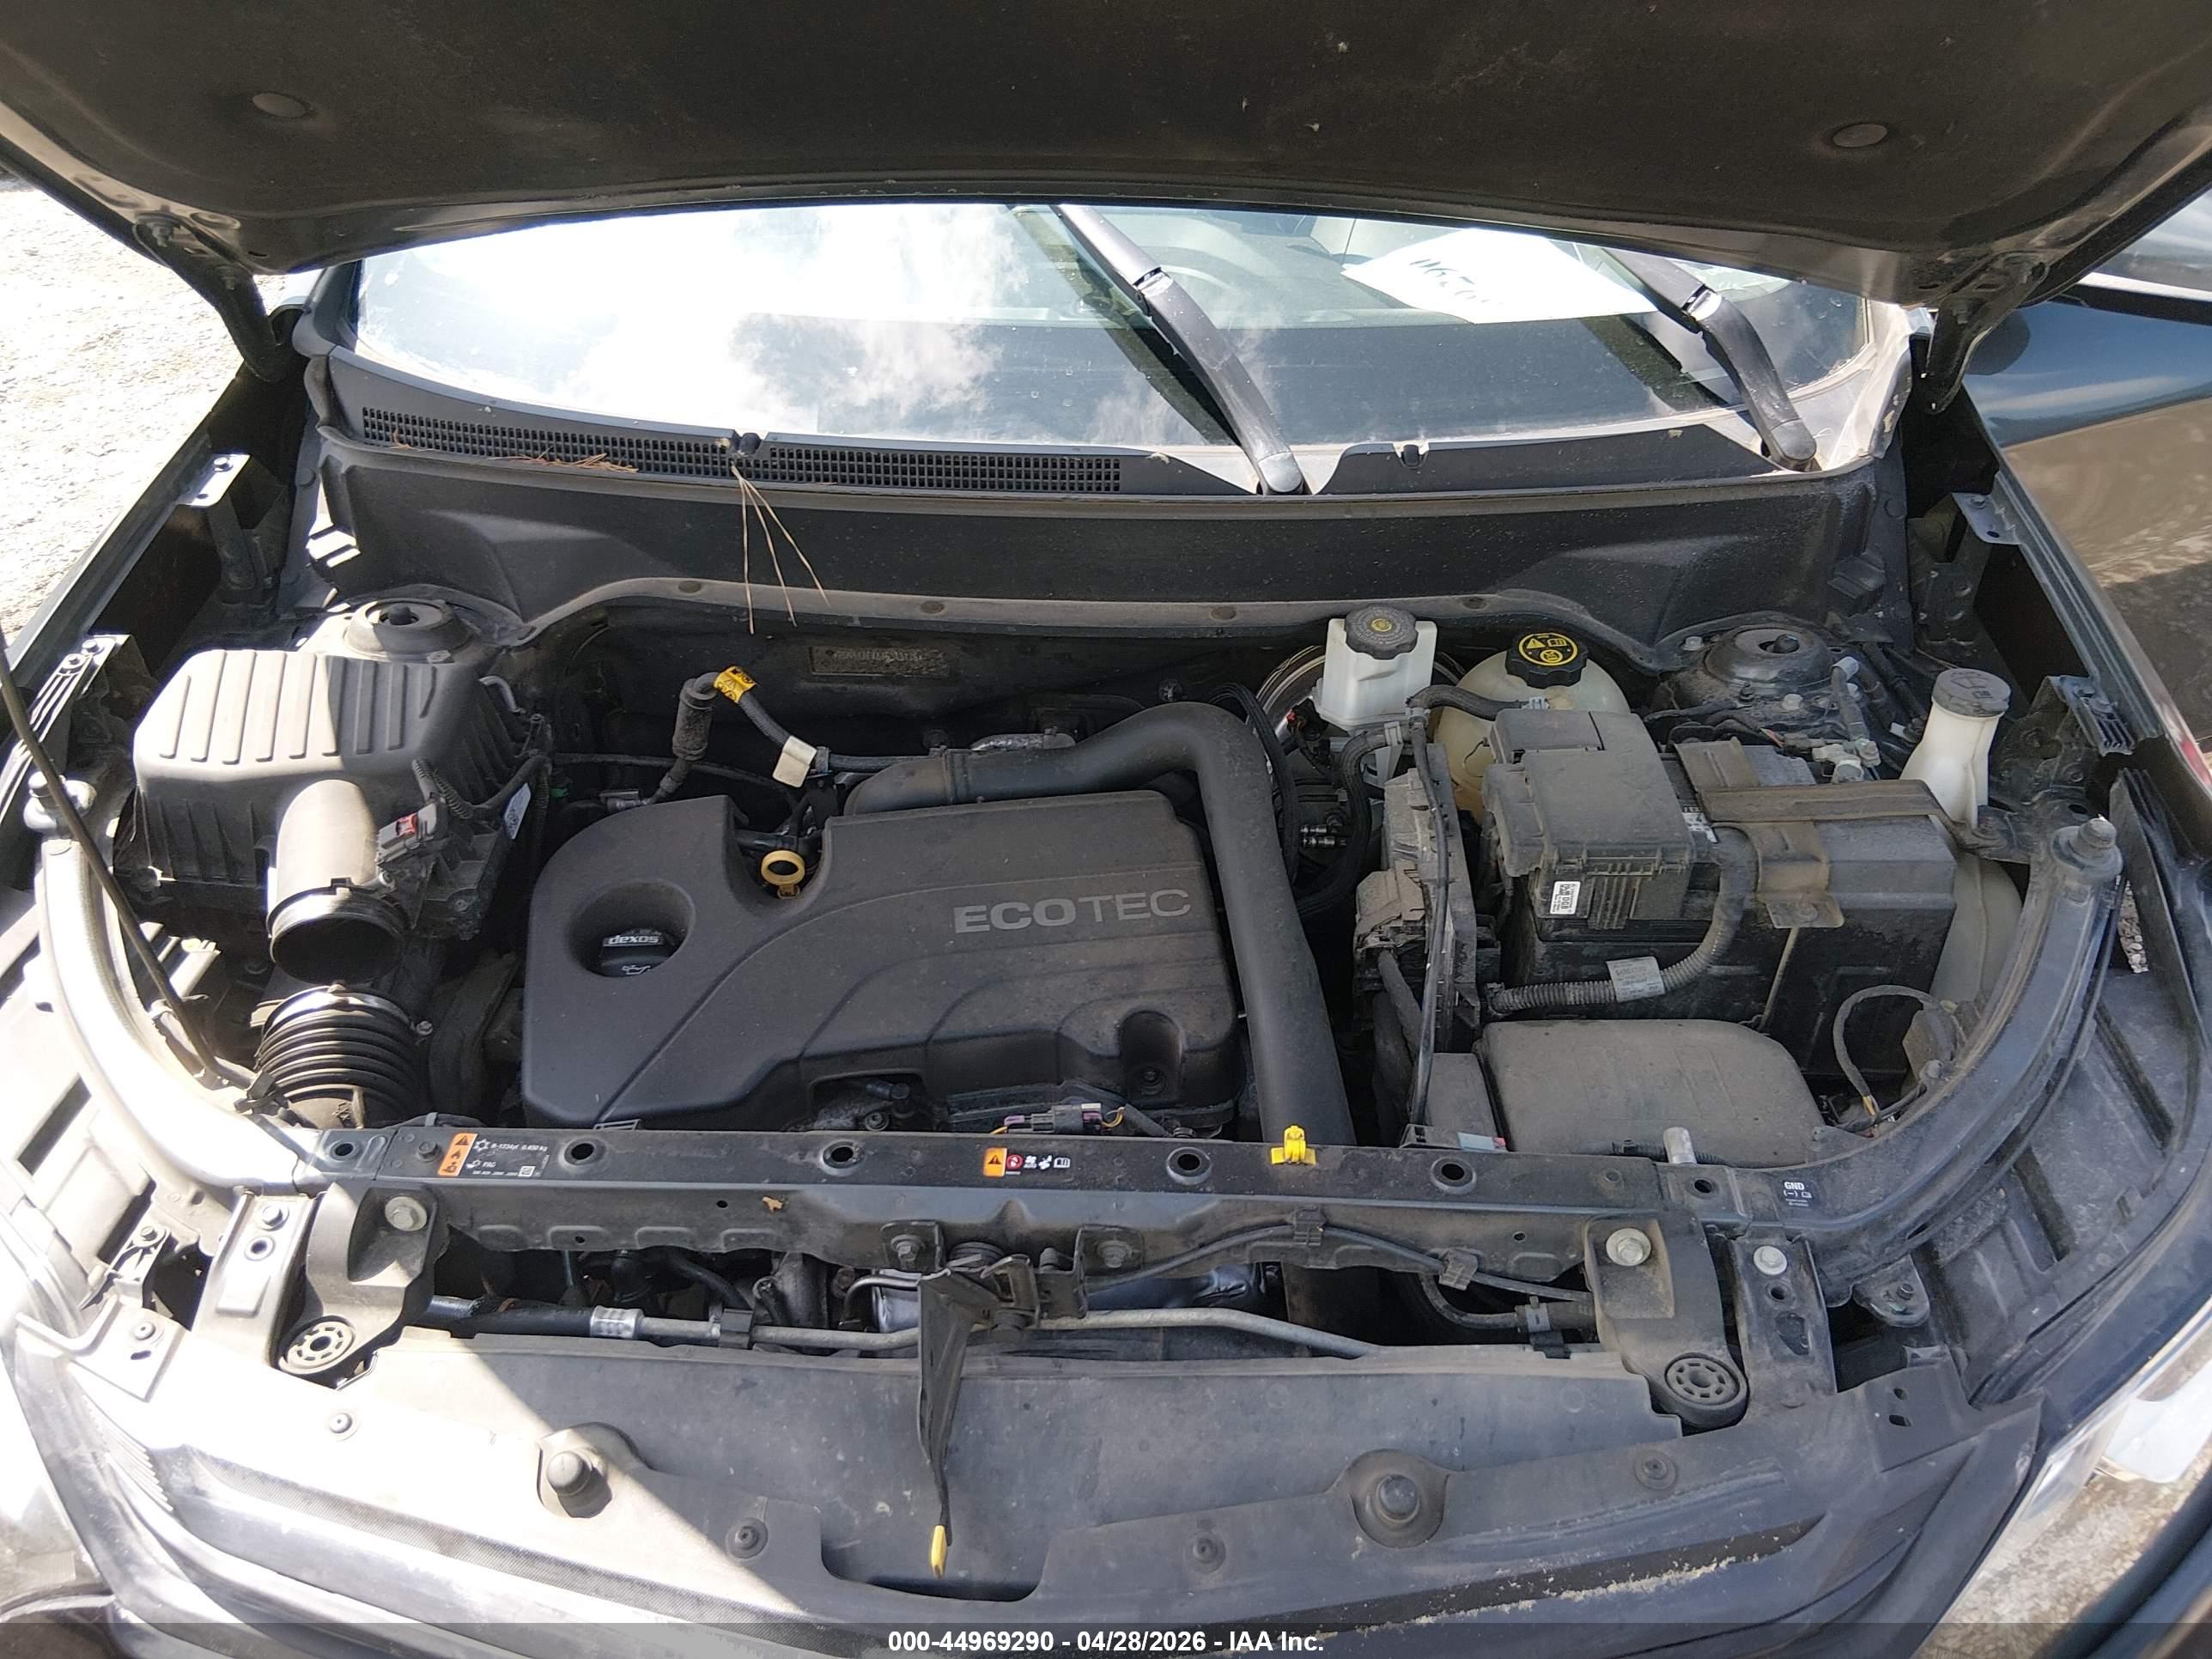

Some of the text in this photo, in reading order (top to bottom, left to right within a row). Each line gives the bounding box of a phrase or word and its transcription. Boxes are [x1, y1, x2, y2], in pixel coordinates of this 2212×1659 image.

[953, 889, 1191, 933] ECOTEC
[608, 934, 659, 945] dexos
[1784, 1181, 1805, 1191] GND
